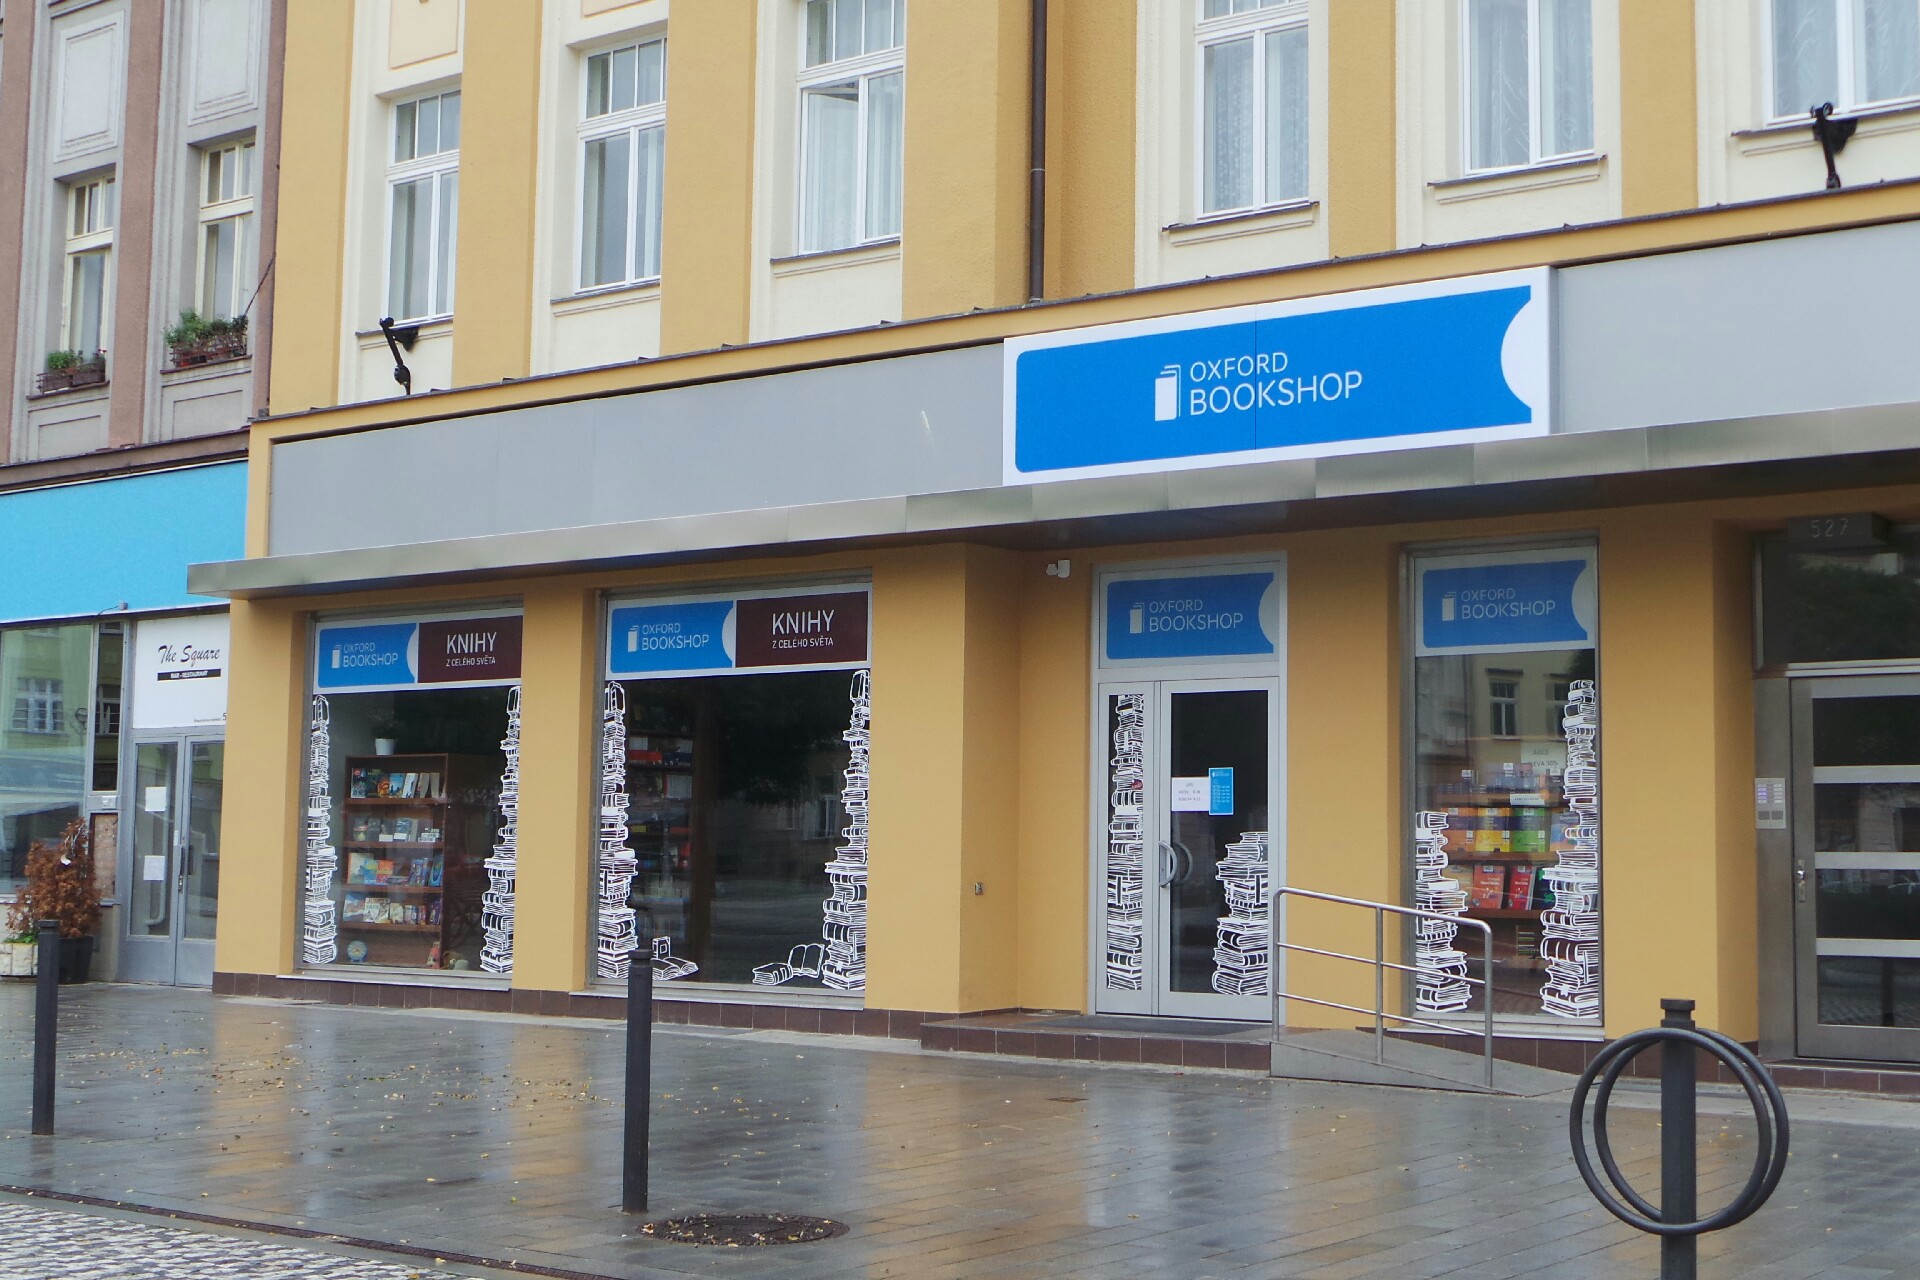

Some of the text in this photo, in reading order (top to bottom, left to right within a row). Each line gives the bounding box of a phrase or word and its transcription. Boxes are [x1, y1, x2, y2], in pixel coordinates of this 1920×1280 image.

[1190, 352, 1288, 382] OXFORD
[1190, 370, 1363, 416] BOOKSHOP
[1811, 518, 1849, 538] 527
[1461, 588, 1516, 602] OXFORD
[1149, 599, 1204, 614] OXFORD
[1461, 600, 1556, 620] BOOKSHOP
[642, 622, 681, 635] OXFORD
[772, 609, 835, 636] KNIHY
[1149, 612, 1244, 632] BOOKSHOP
[343, 642, 376, 654] OXFORD
[446, 631, 498, 655] KNIHY
[641, 634, 710, 651] BOOKSHOP
[772, 635, 834, 649] Z CELÉHO SVĚTA
[158, 644, 221, 667] The Square
[342, 652, 399, 668] BOOKSHOP
[446, 654, 497, 667] Z CELÉHO SVĚTA
